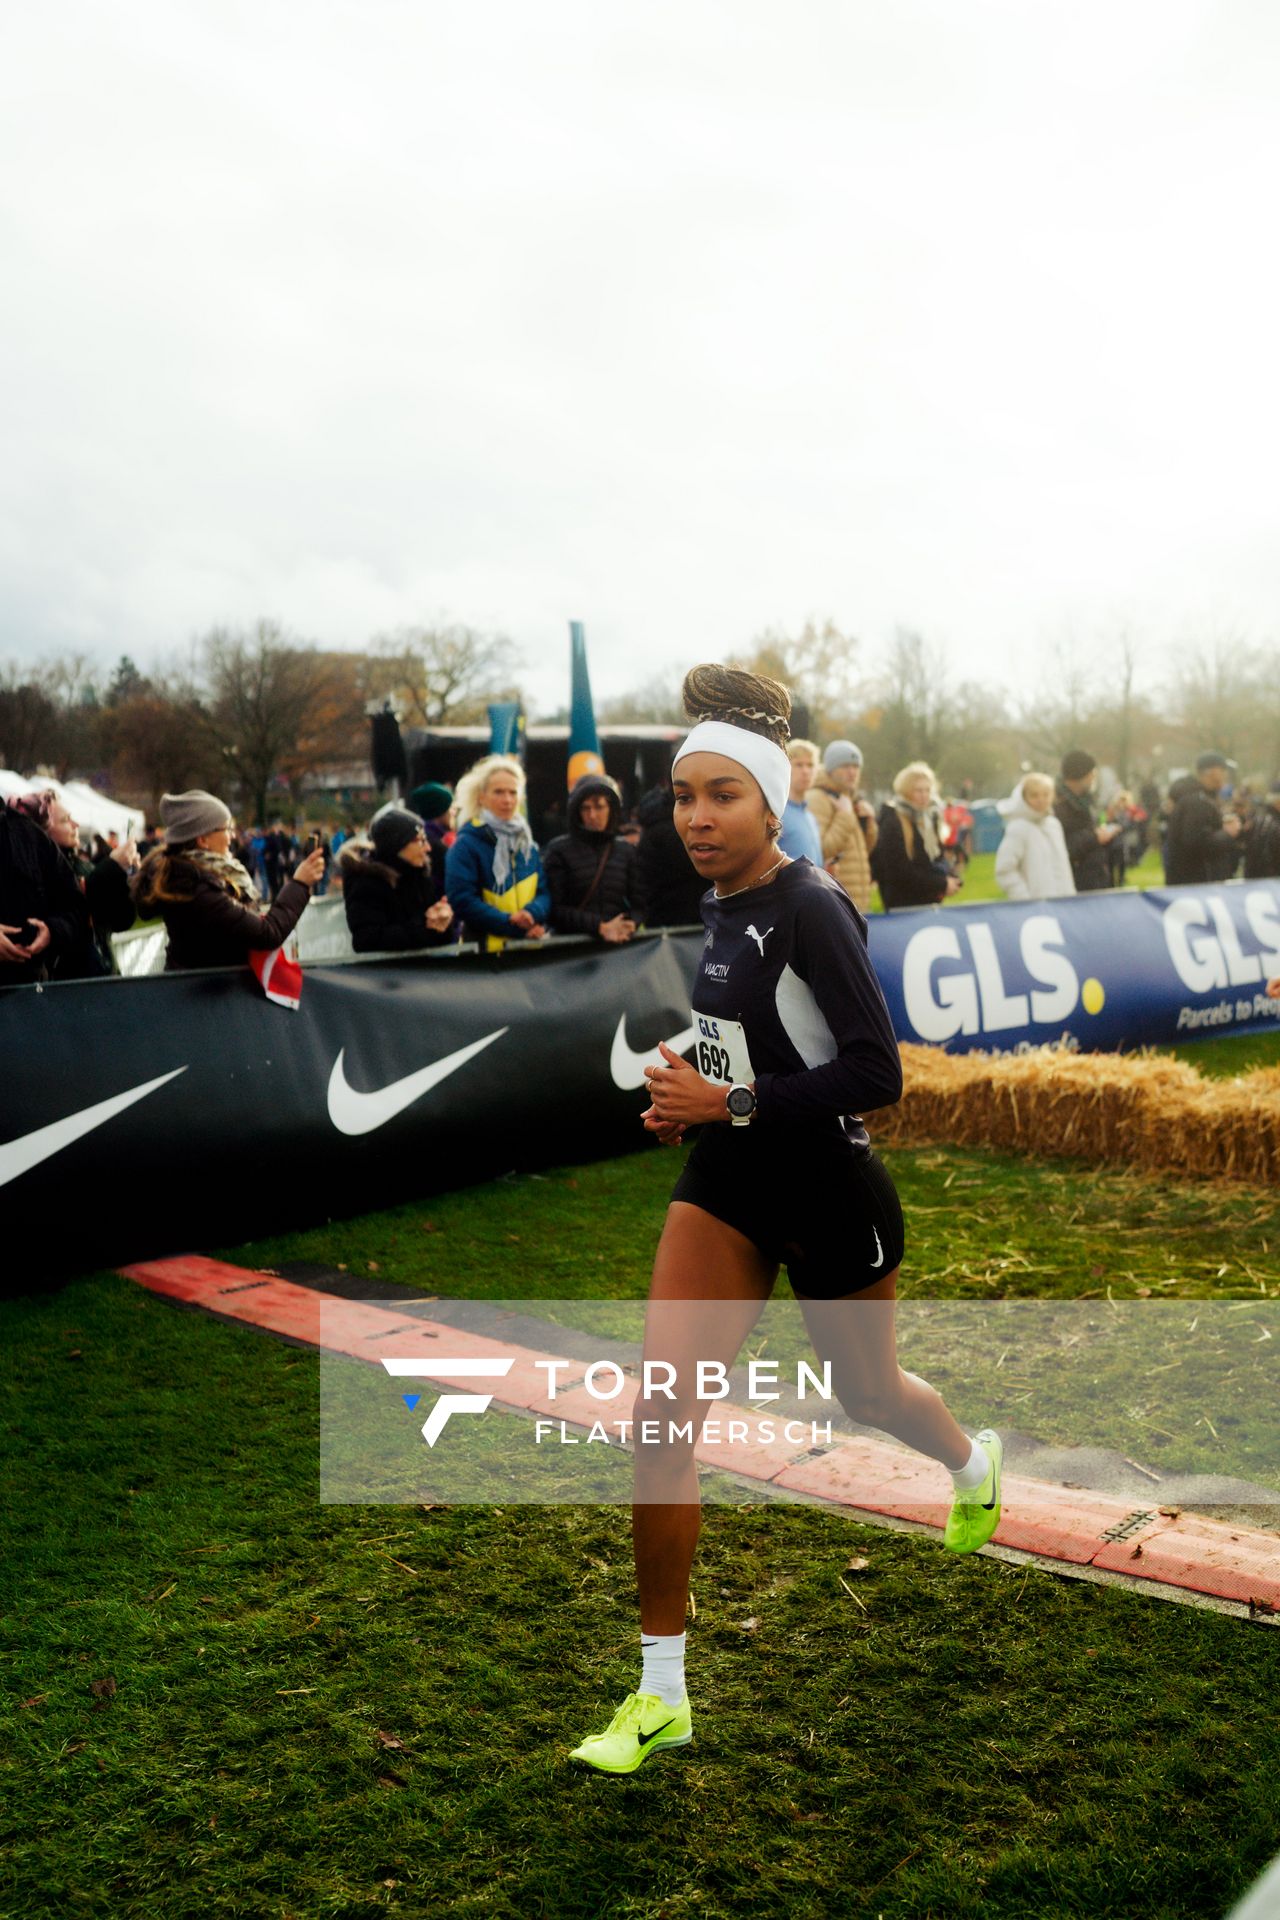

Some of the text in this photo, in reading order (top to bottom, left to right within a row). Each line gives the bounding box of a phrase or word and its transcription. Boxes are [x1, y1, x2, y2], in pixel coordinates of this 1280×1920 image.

[704, 962, 730, 977] VIACTIV
[1176, 1000, 1234, 1030] Parcels
[1235, 999, 1252, 1021] to
[699, 1041, 734, 1083] 692
